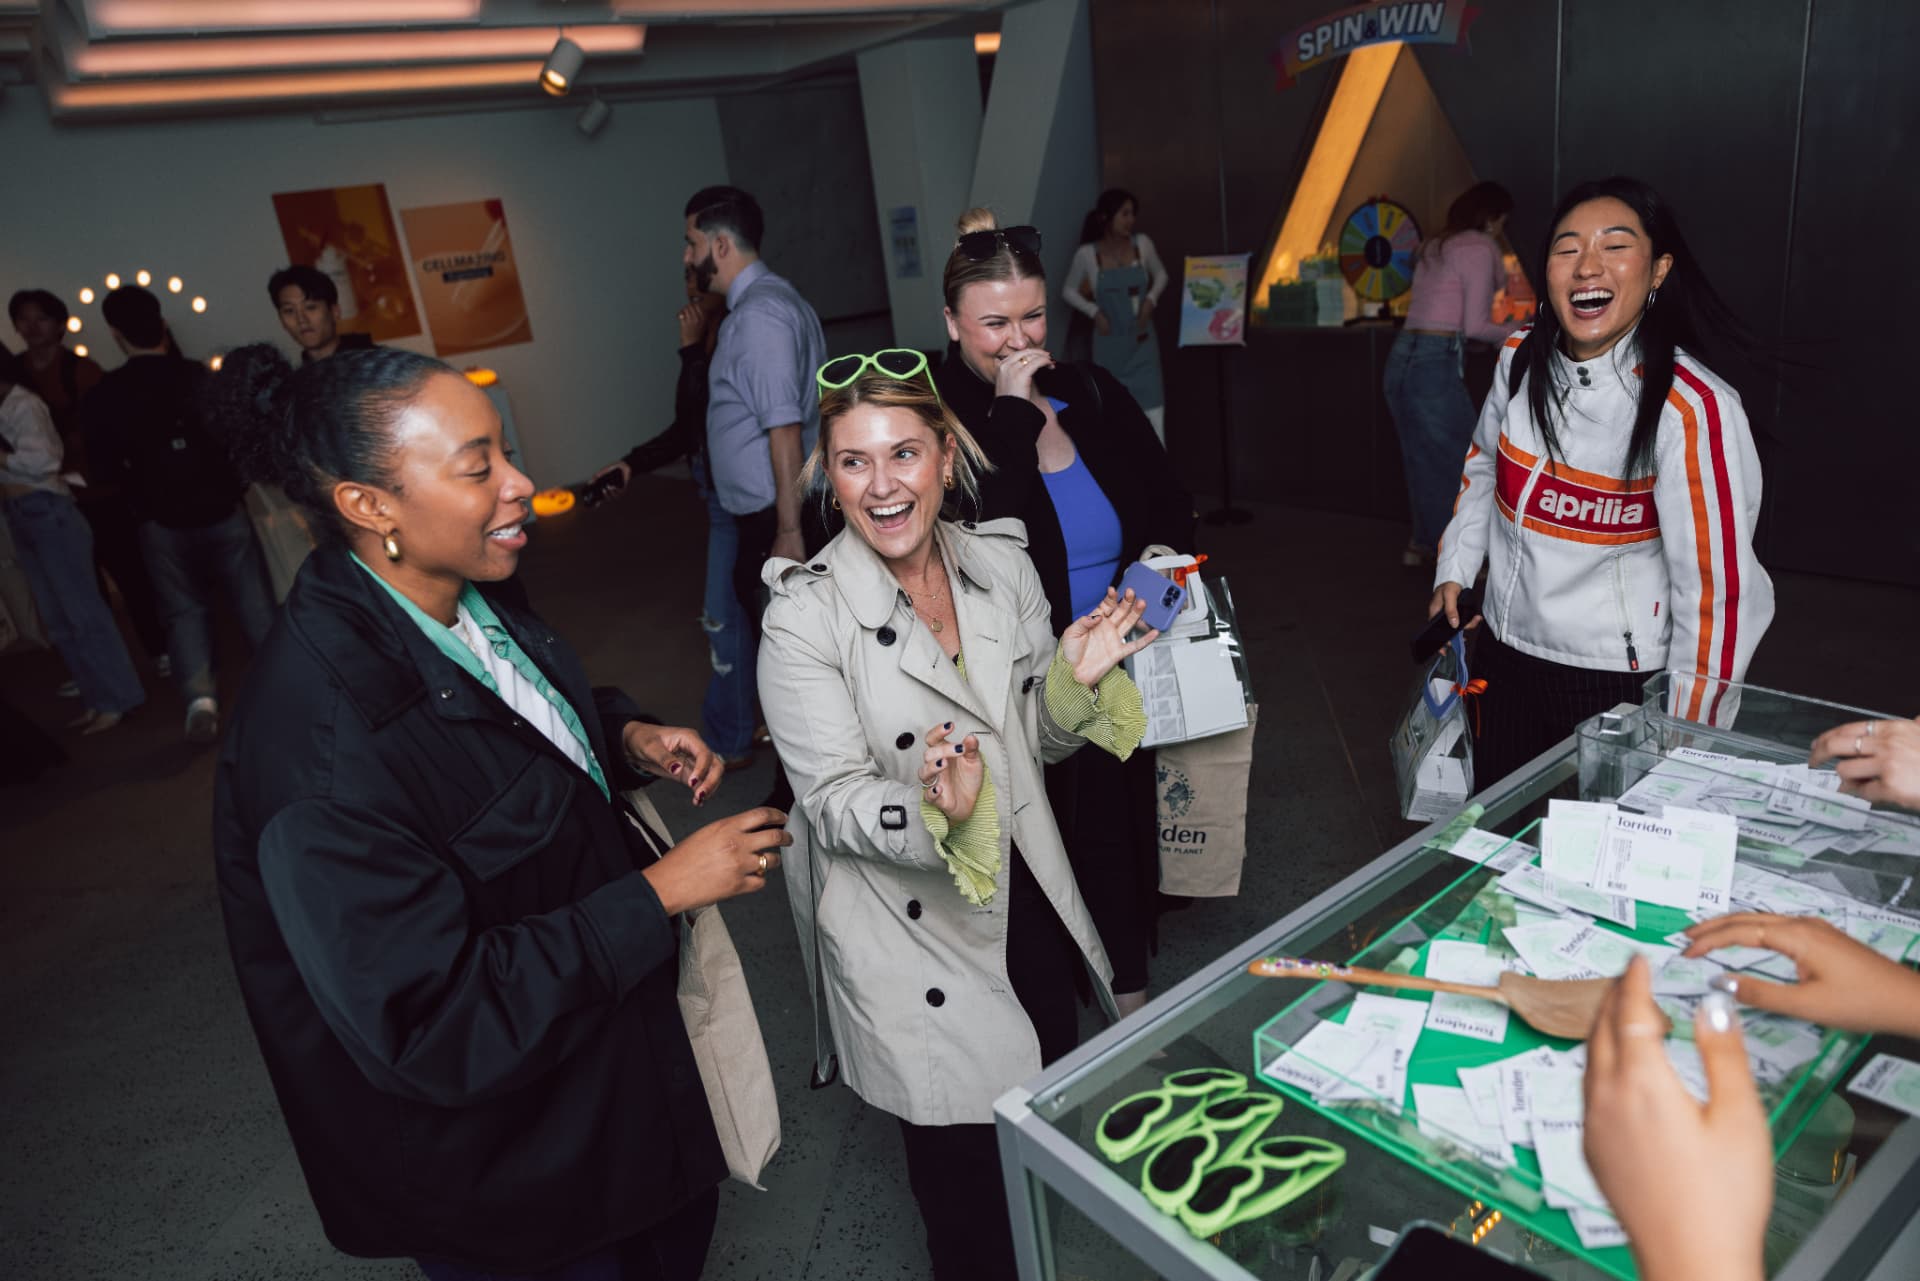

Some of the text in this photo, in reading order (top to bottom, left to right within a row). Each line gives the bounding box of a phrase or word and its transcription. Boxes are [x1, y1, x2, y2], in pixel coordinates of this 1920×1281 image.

[1297, 13, 1364, 62] SPIN
[1379, 1, 1444, 36] WIN
[1538, 488, 1644, 525] aprilia
[1681, 748, 1729, 762] Torriden
[1616, 815, 1673, 837] Torriden
[1174, 847, 1205, 856] PLANET
